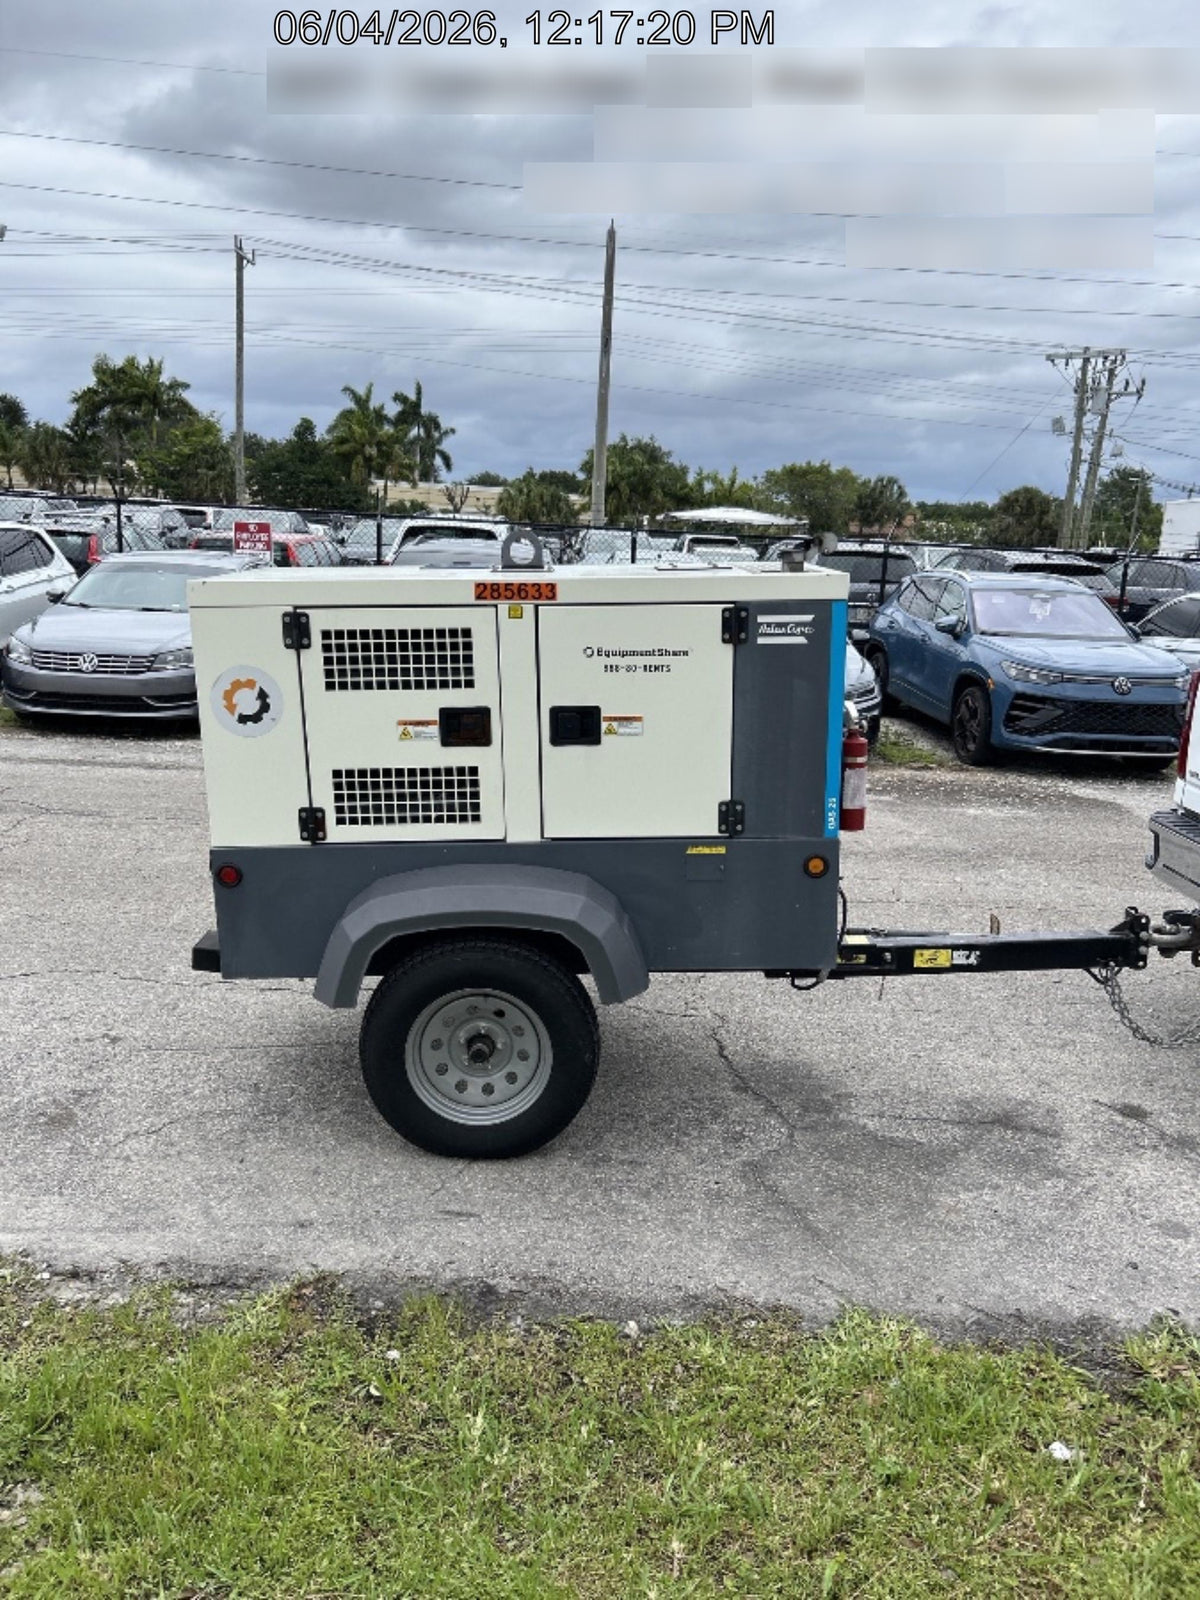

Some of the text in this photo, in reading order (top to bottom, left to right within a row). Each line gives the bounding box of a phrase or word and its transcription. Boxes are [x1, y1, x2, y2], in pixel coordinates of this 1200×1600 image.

[475, 582, 557, 600] 285633
[758, 623, 786, 634] Atlas
[596, 647, 689, 658] EquipmentShare
